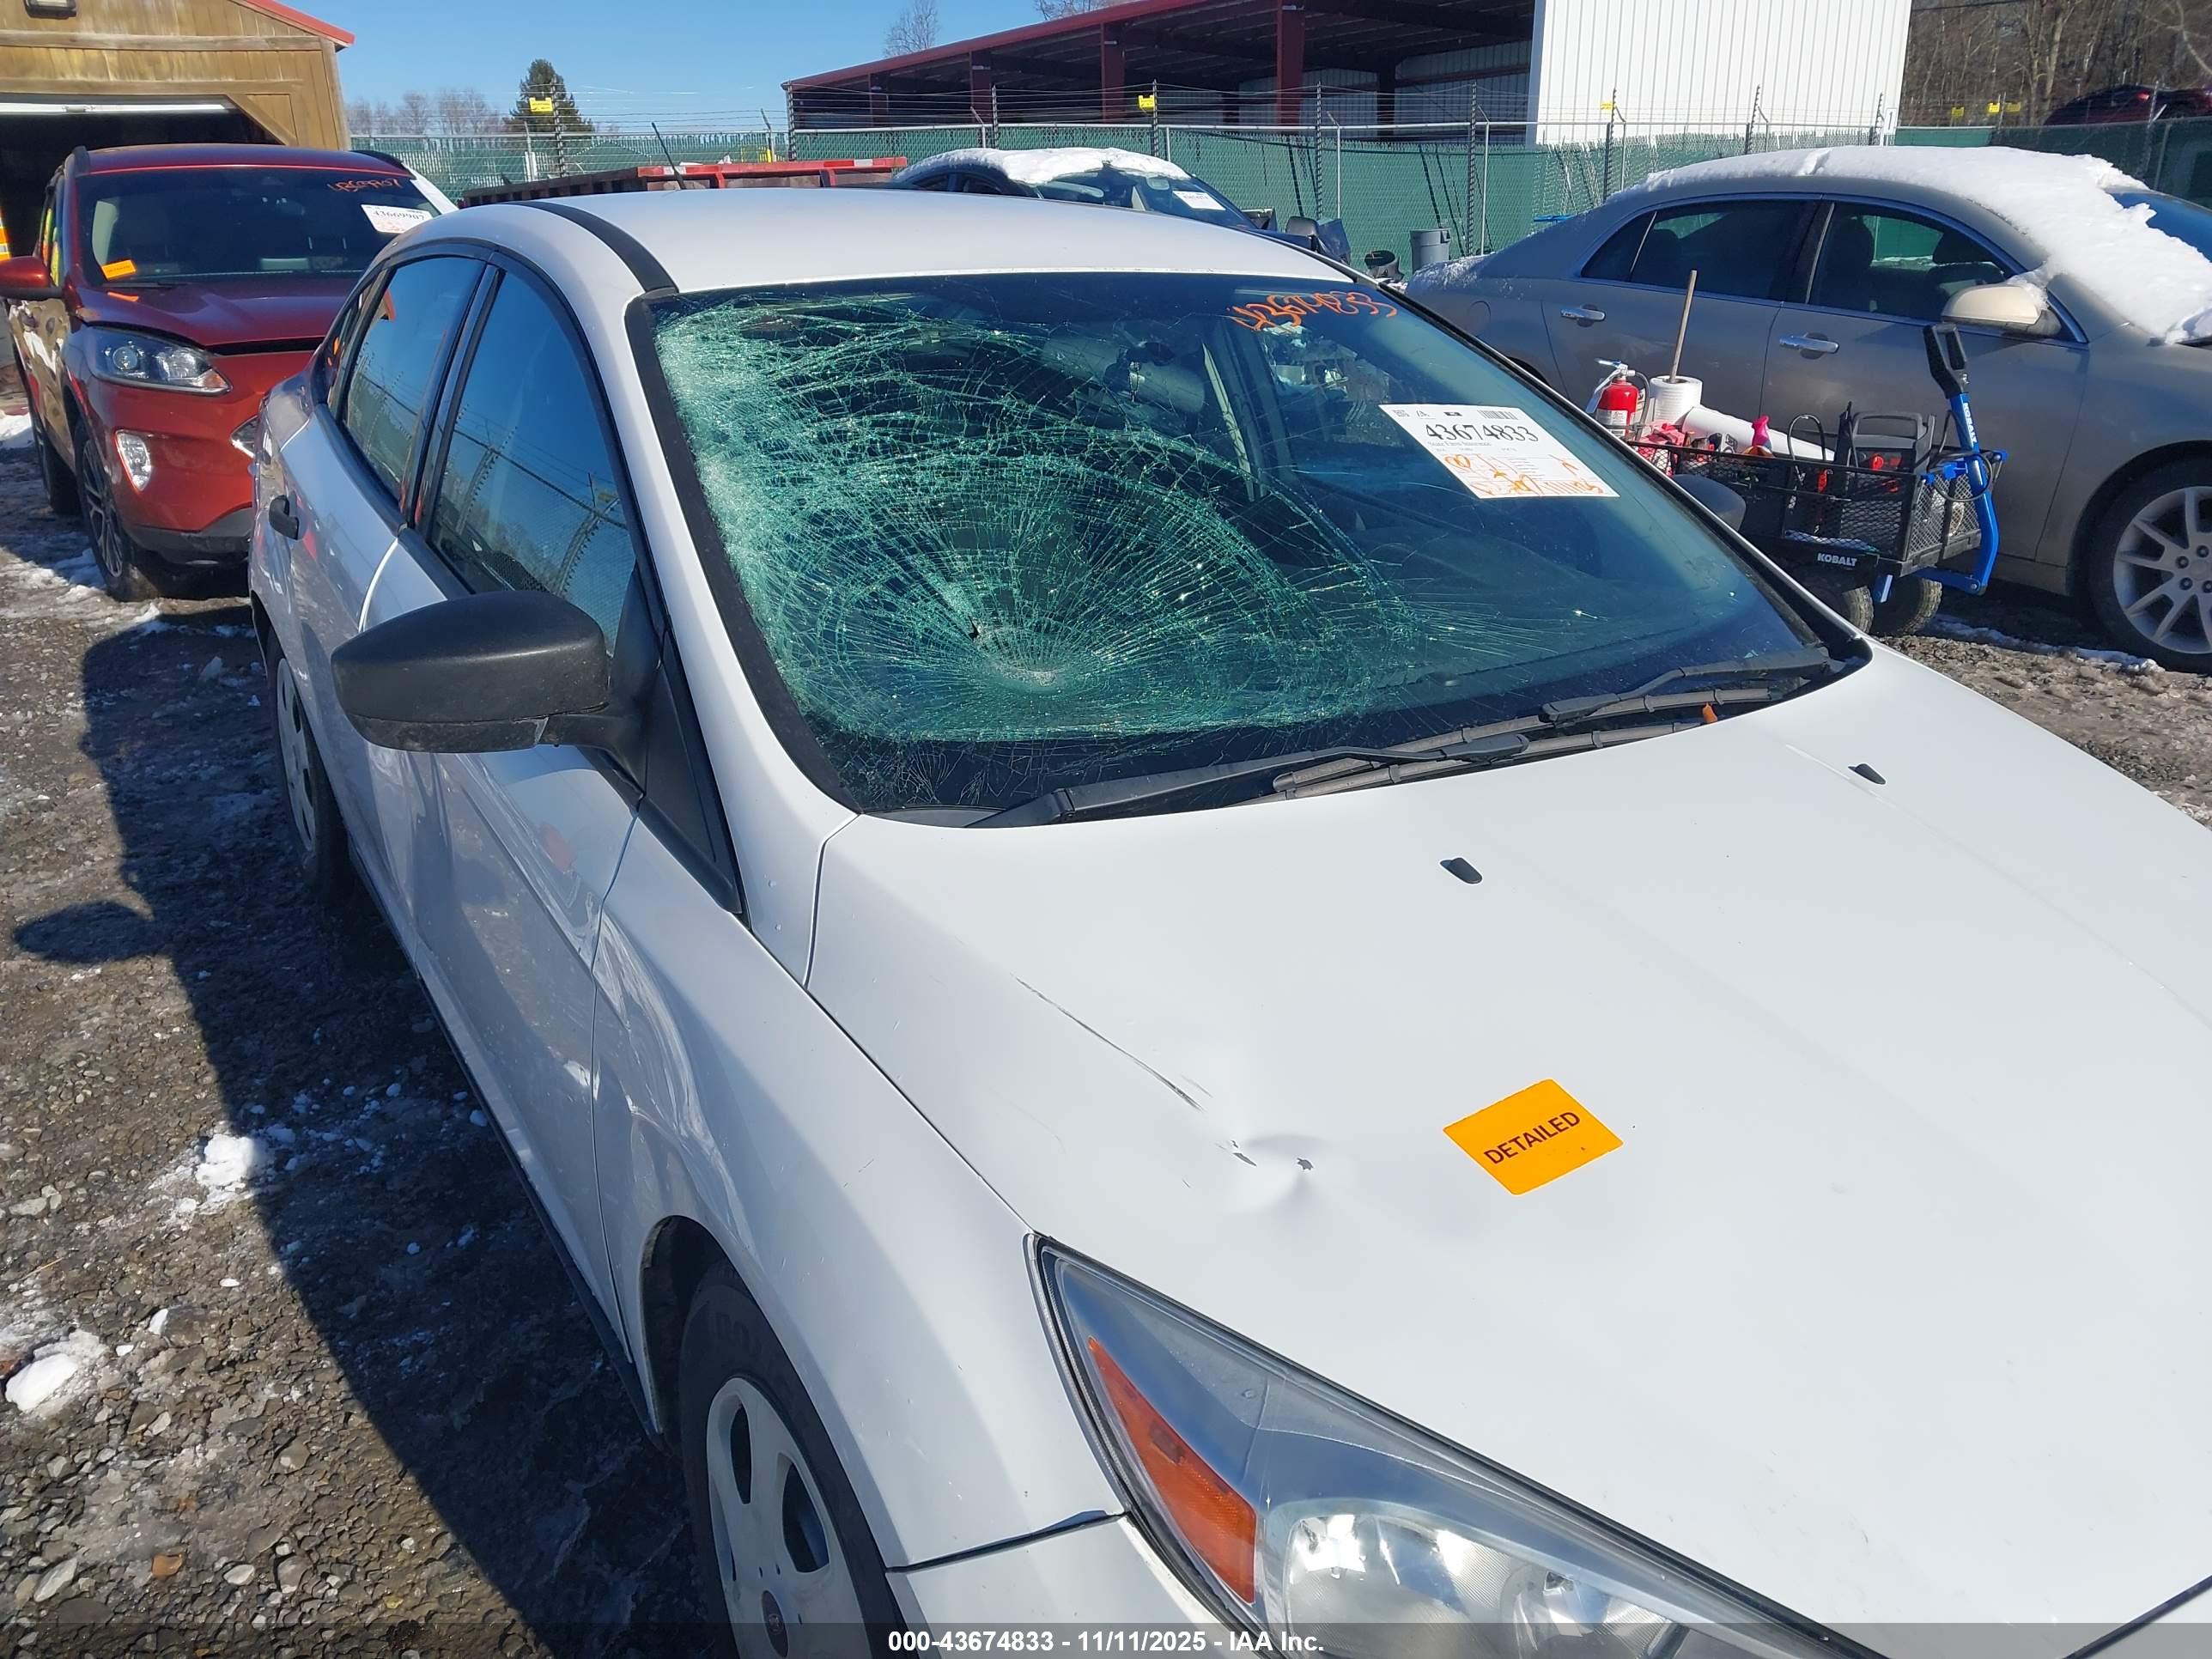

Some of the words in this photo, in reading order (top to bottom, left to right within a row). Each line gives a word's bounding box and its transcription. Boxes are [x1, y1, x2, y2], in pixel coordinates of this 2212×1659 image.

[1425, 423, 1539, 443] 43674833
[1817, 552, 1857, 567] KOBALT
[1483, 1111, 1581, 1165] DETAILED
